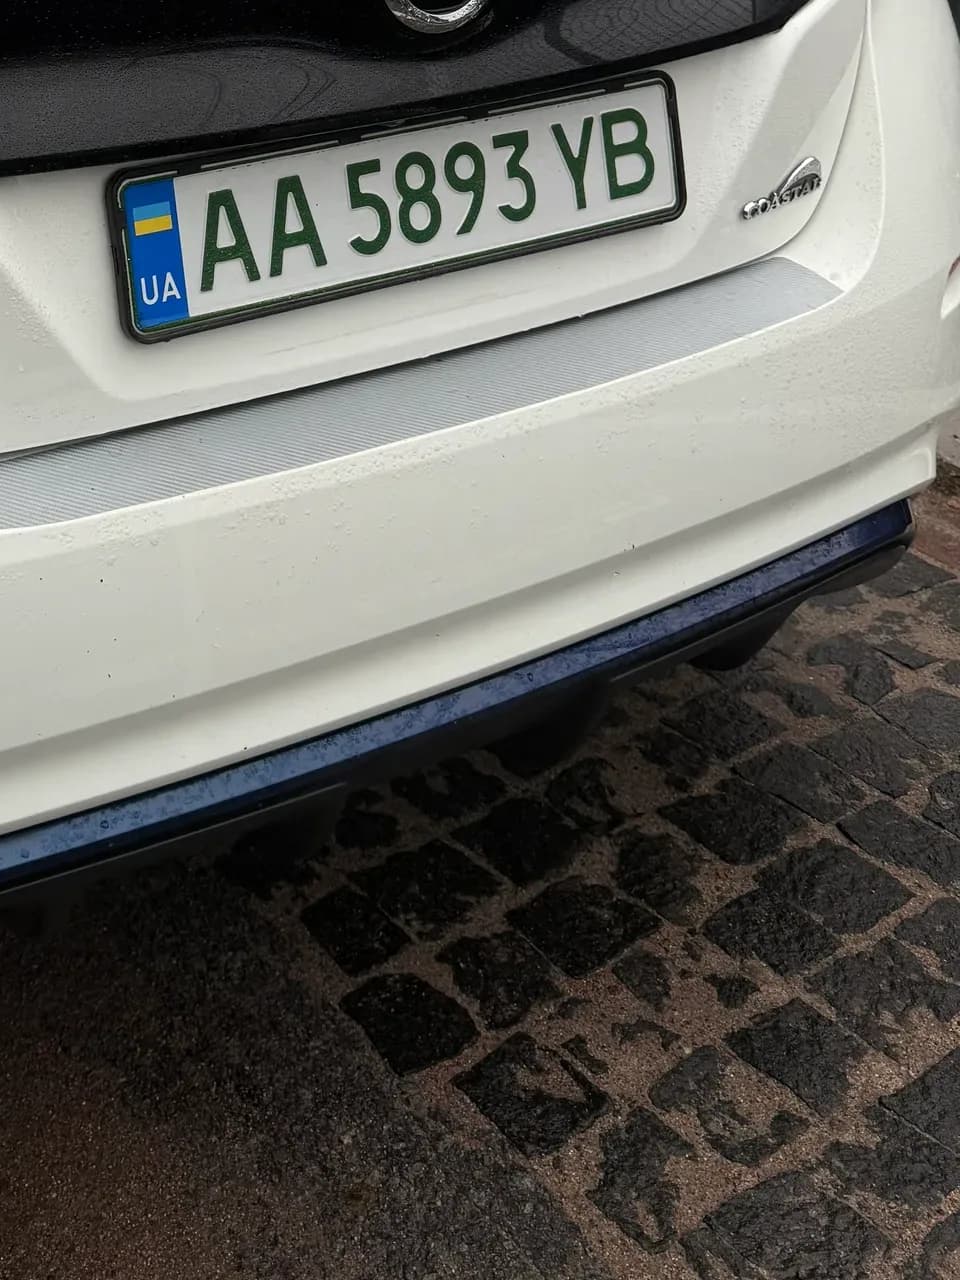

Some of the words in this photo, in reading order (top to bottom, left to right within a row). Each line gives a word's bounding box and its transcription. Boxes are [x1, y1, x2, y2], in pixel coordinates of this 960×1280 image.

[200, 174, 328, 292] AA
[346, 129, 537, 256] 5893
[140, 271, 182, 306] UA
